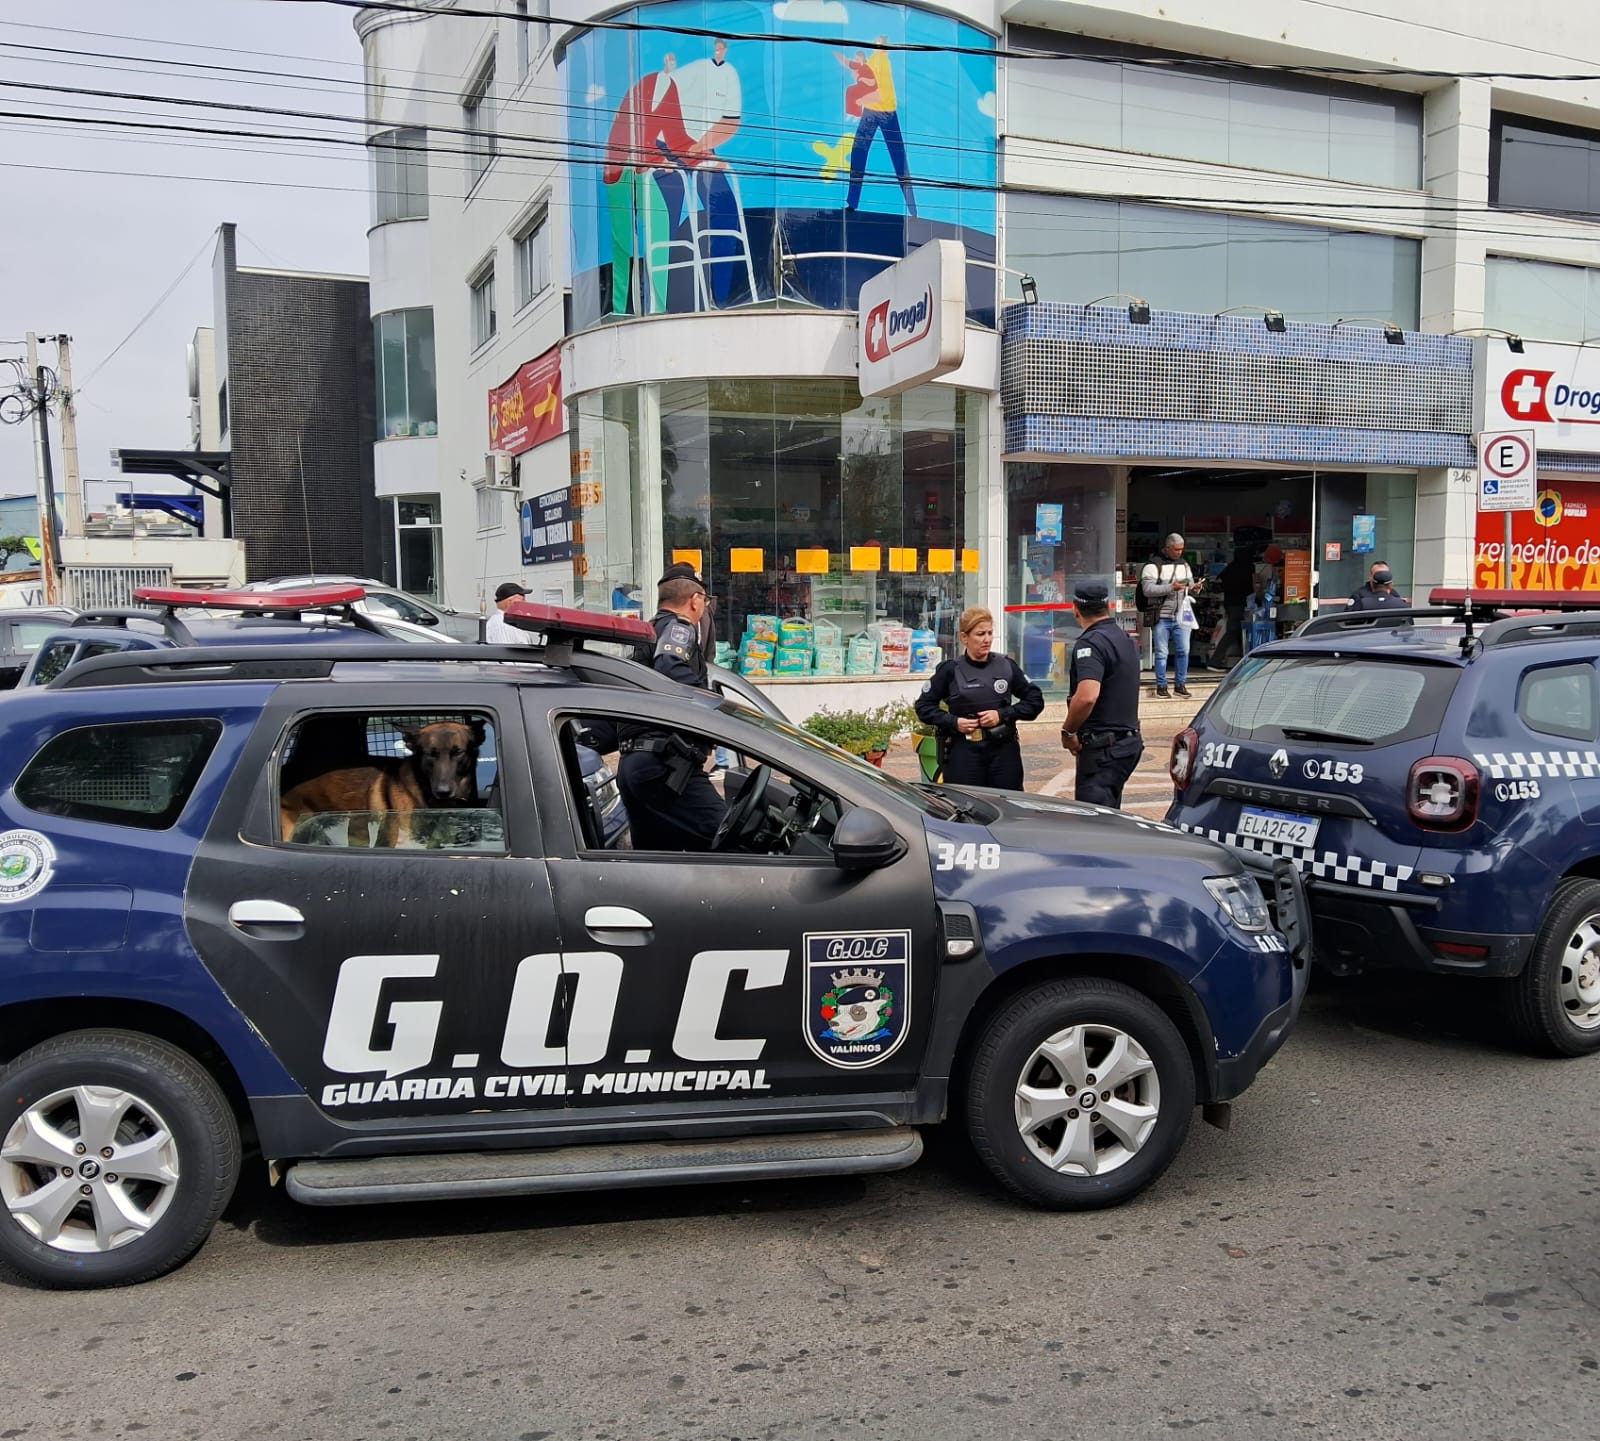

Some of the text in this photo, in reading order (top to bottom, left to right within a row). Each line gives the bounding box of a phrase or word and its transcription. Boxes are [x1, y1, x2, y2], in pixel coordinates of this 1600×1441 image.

[888, 291, 928, 336] Drogal
[1554, 384, 1600, 415] Drog
[1500, 445, 1514, 468] E
[1476, 537, 1569, 564] remédio
[1202, 742, 1364, 784] 317 153
[1226, 784, 1331, 809] DUSTER
[1508, 780, 1541, 800] 153
[1242, 816, 1308, 843] ELA2F42
[936, 843, 1001, 871] 348
[826, 936, 889, 960] G.O.C
[322, 949, 790, 1079] G.O.C
[830, 1044, 882, 1054] VALINHOS
[321, 1068, 771, 1106] GUARDA CIVIL MUNICIPAL
